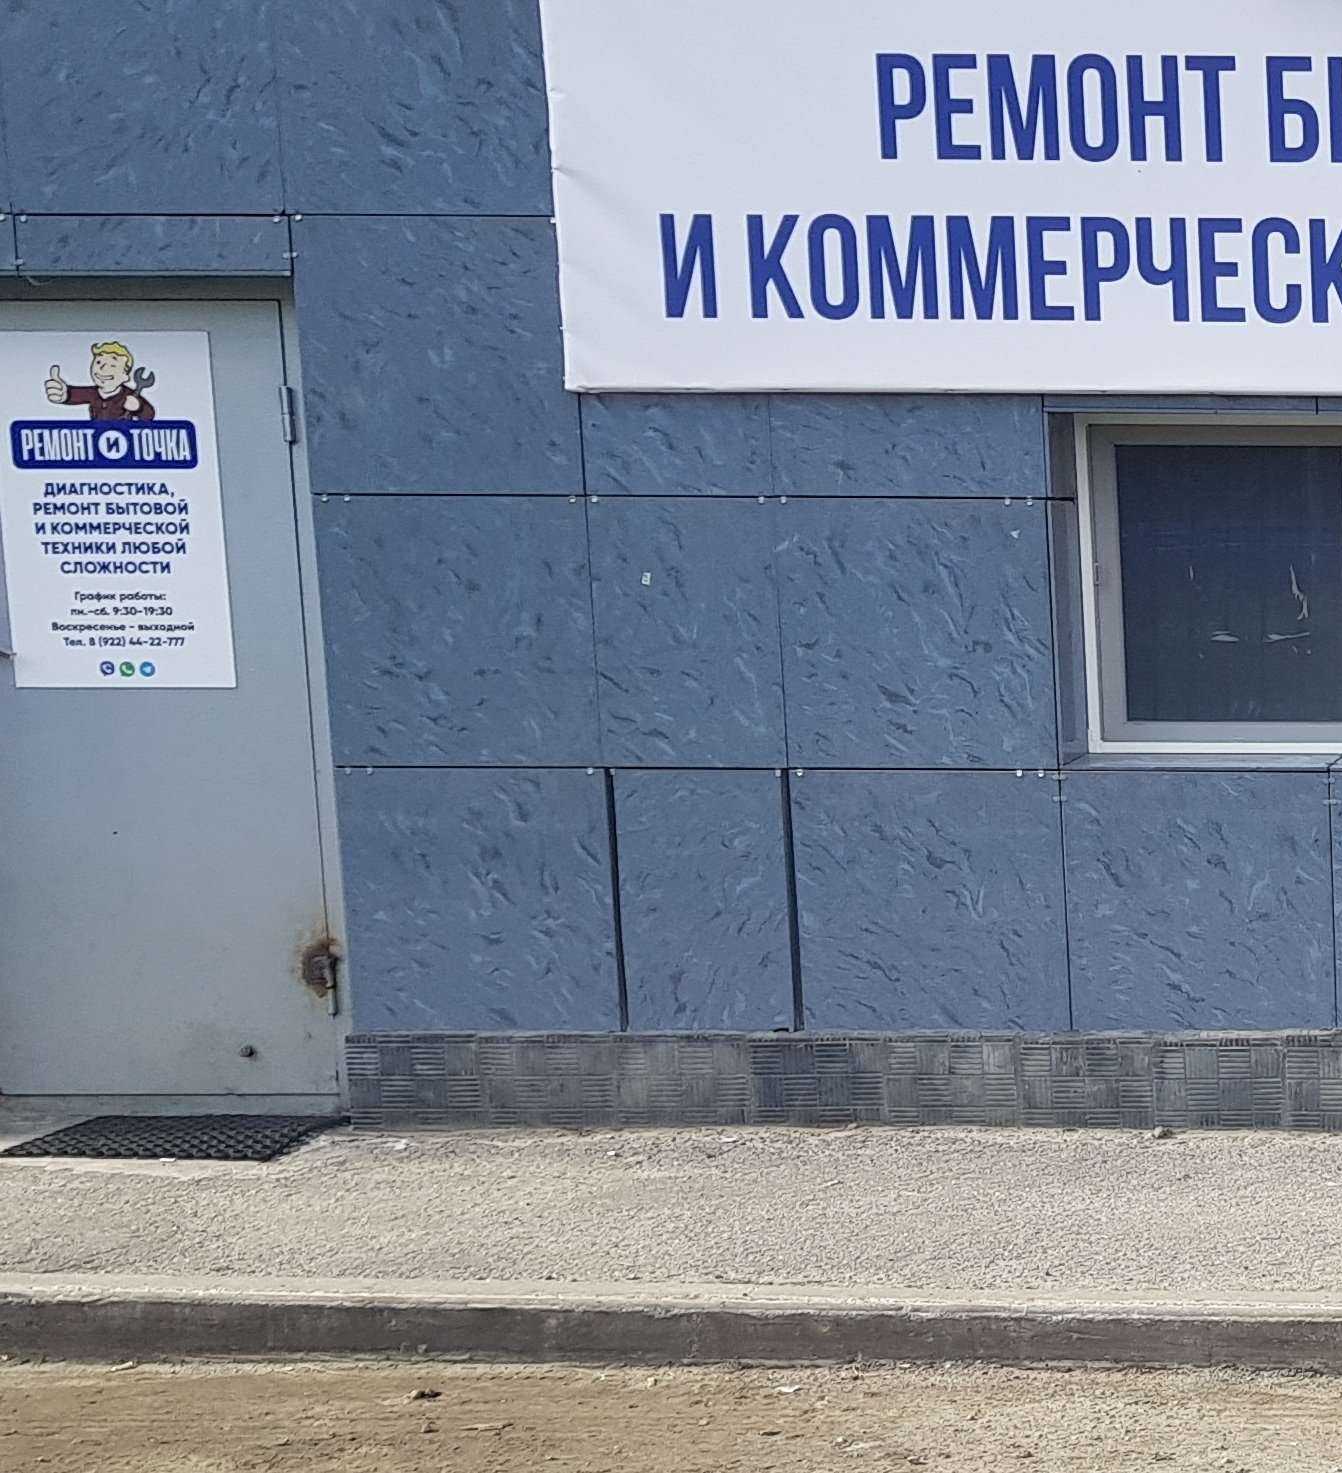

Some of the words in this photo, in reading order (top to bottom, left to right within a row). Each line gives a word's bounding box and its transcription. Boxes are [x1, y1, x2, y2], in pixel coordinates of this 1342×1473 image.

[874, 51, 1237, 163] РЕМОНТ
[658, 212, 719, 319] И
[21, 428, 96, 461] РЕМОНТ
[129, 428, 191, 461] ТОЧКА
[44, 482, 174, 498] ДИАГНОСТИКА,
[33, 502, 100, 515] РЕМОНТ
[105, 499, 189, 516] БЫТОВОЙ
[35, 522, 46, 535] И
[50, 519, 190, 535] КОММЕРЧЕСКОЙ
[42, 542, 117, 555] ТЕХНИКИ
[121, 539, 186, 555] ЛЮБОЙ
[60, 561, 171, 574] СЛОЖНОСТИ
[74, 591, 116, 602] График
[120, 591, 166, 602] работы:
[113, 606, 173, 616] 9:30-19:30
[51, 622, 126, 633] Воскресенье
[138, 621, 195, 633] выходной
[63, 637, 86, 646] Тел.
[89, 637, 95, 646] 8
[99, 636, 126, 647] (922)
[129, 637, 185, 646] 44-22-777
